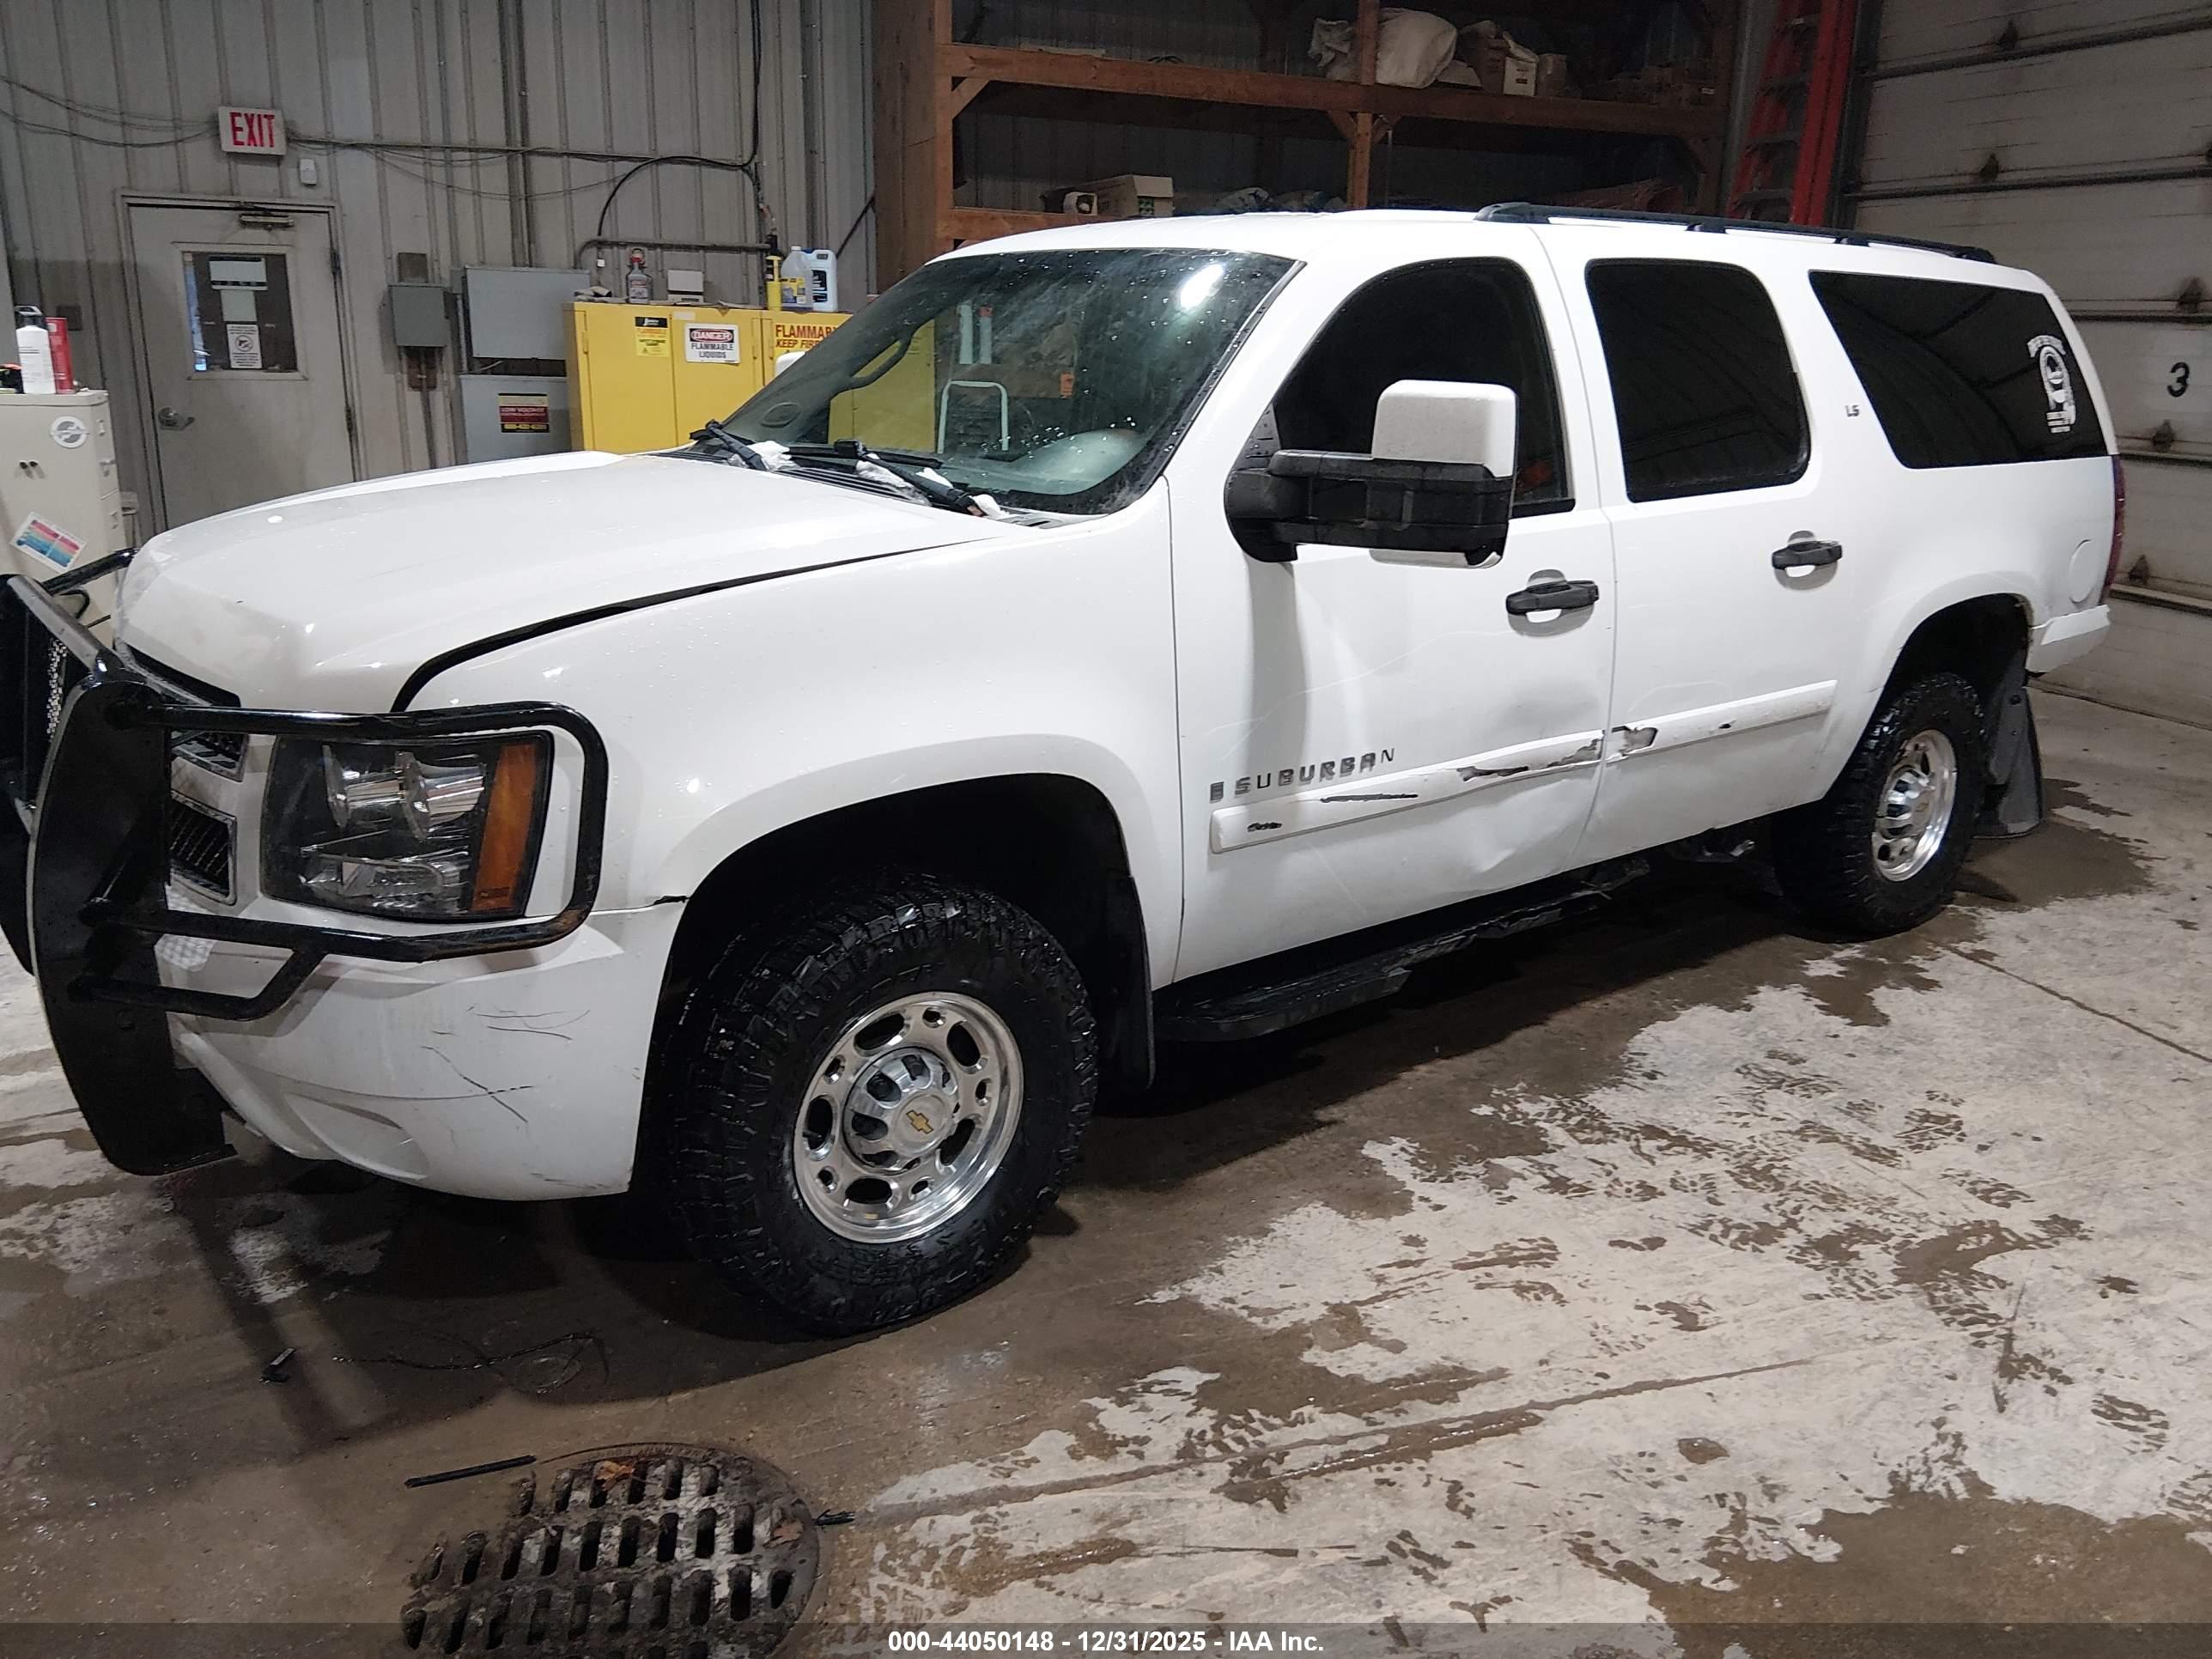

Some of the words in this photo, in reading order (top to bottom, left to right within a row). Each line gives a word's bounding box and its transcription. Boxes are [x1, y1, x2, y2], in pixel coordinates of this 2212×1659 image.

[229, 112, 275, 148] EXIT
[693, 331, 731, 341] DANGER
[690, 343, 735, 351] FLAMMABLE
[775, 339, 799, 349] KEEP
[699, 350, 727, 359] LIQUIDS
[2166, 362, 2190, 398] 3
[1234, 748, 1395, 797] SUBURBAN
